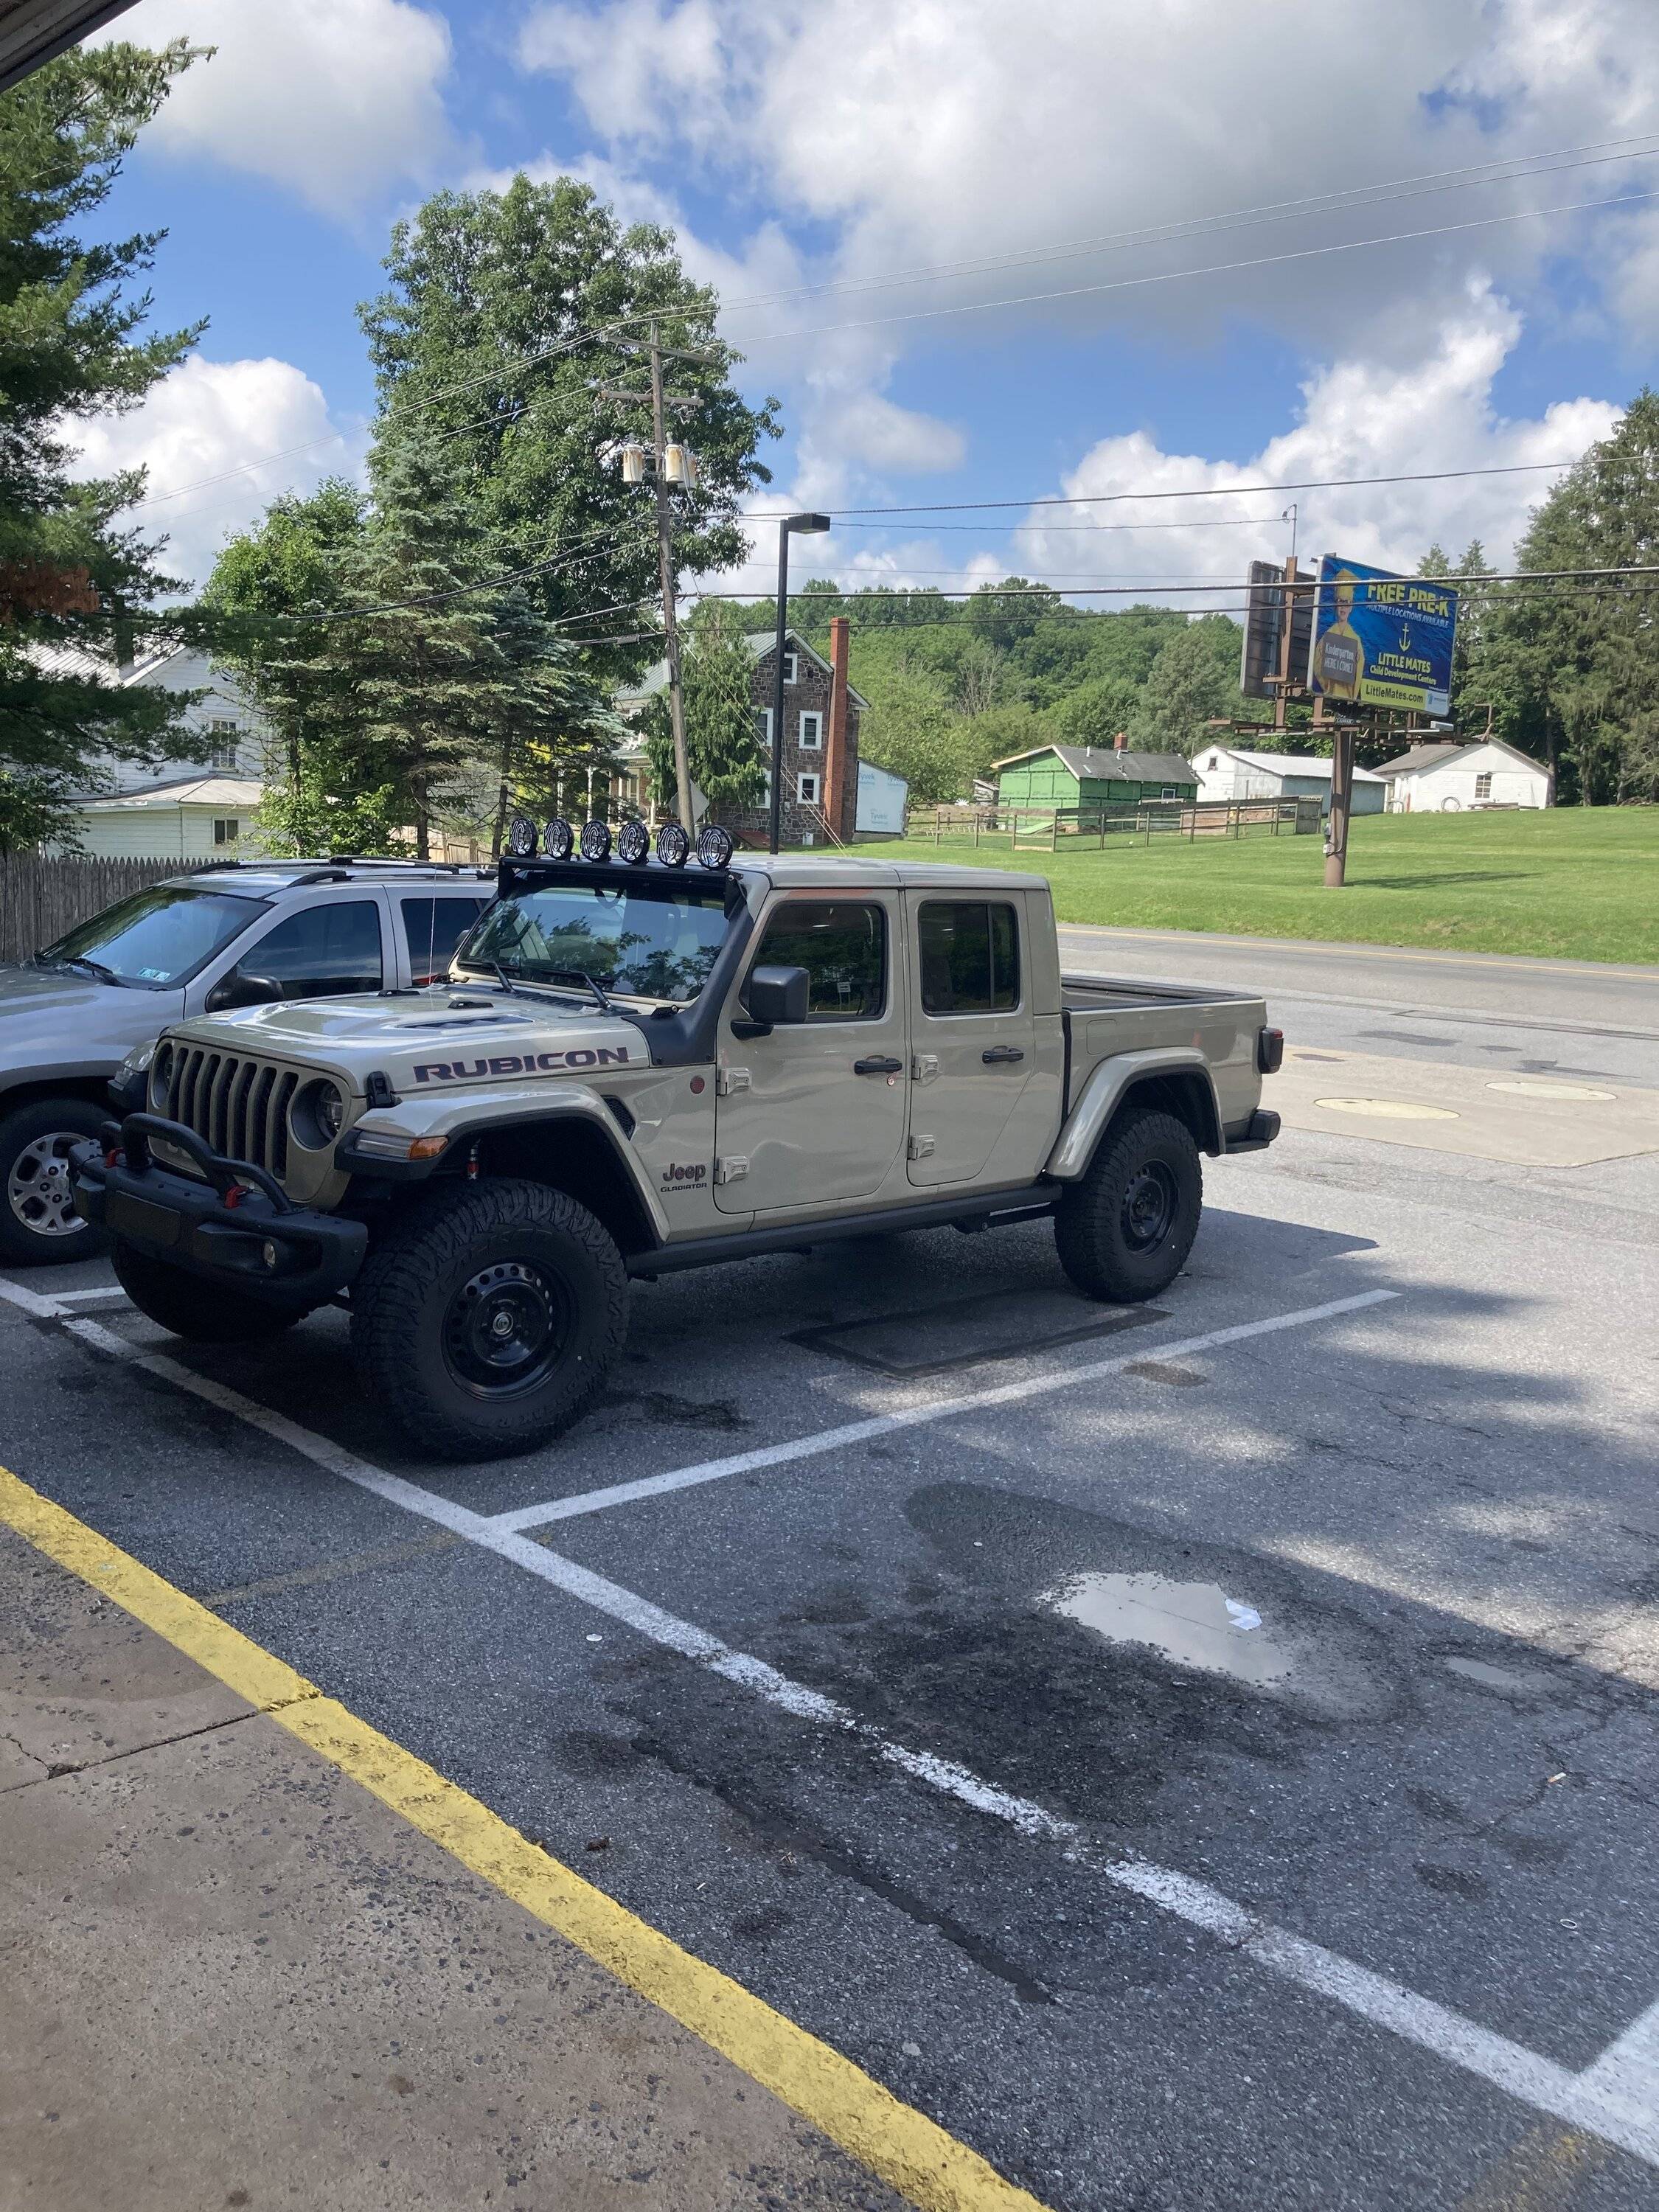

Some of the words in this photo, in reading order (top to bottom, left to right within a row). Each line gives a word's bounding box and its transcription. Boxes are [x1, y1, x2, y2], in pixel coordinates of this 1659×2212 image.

[1368, 578, 1405, 605] FREE
[1408, 588, 1449, 617] PRE-K
[1366, 603, 1392, 616] MULTIPLE
[1392, 608, 1422, 622] LOCATIONS
[1422, 614, 1449, 628] AVAILABLE
[1370, 665, 1384, 675] Child
[1384, 667, 1417, 681] Development
[1417, 674, 1437, 686] Centers
[1378, 652, 1405, 669] LITTLE
[1405, 657, 1431, 674] MATES
[1366, 684, 1424, 703] LittleMates.com
[509, 821, 524, 852] KC
[543, 822, 560, 855] KC
[580, 824, 598, 856] KC
[618, 825, 636, 857] KC
[656, 827, 676, 862] KC
[696, 830, 720, 867] KC
[413, 1046, 629, 1083] RUBICON
[661, 1183, 707, 1192] GLADIATOR
[663, 1163, 706, 1181] Jeep
